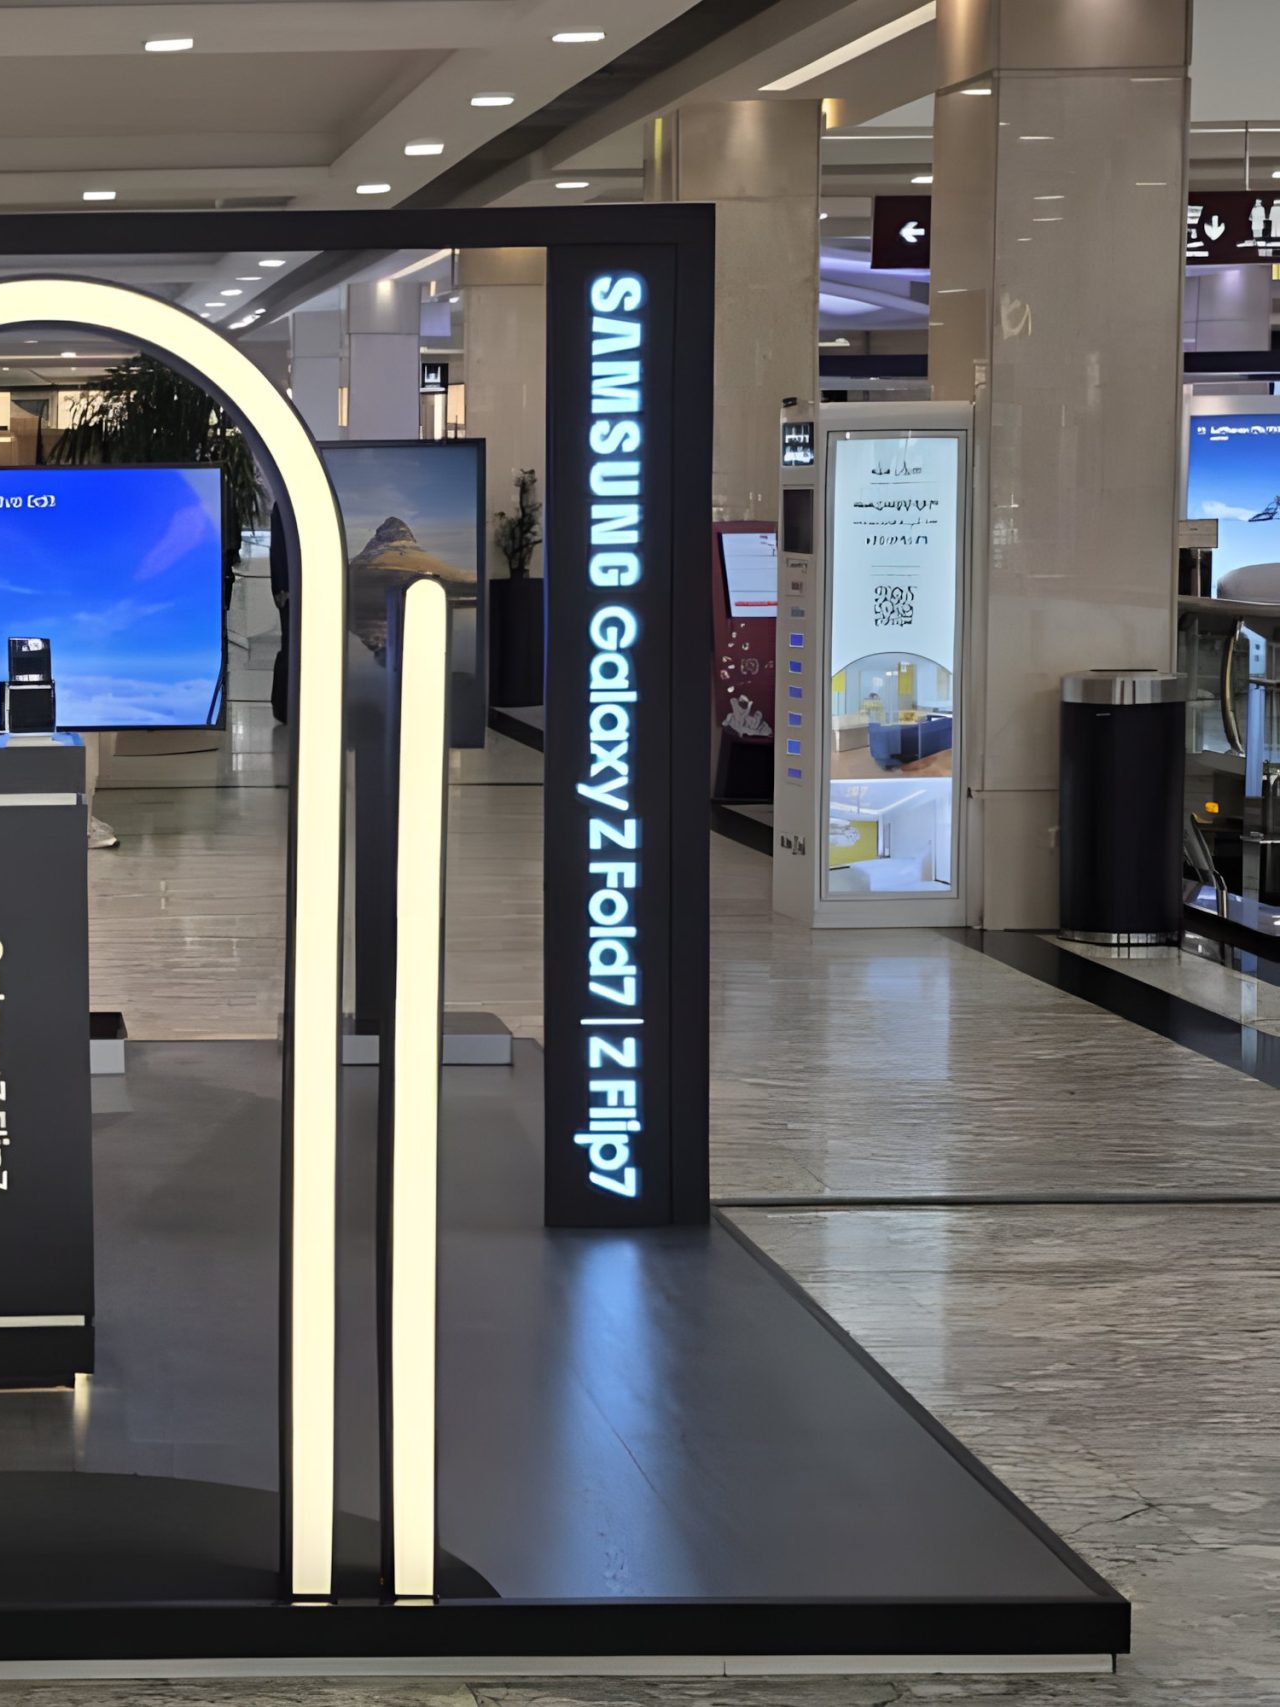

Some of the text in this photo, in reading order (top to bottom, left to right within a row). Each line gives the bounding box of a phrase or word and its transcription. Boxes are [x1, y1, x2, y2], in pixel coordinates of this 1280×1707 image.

[588, 275, 643, 588] SAMSUNG
[575, 604, 639, 811] Galaxy
[587, 817, 638, 851] Z
[587, 860, 638, 1007] Fold7
[587, 1035, 638, 1069] Z
[572, 1078, 642, 1198] Flip7
